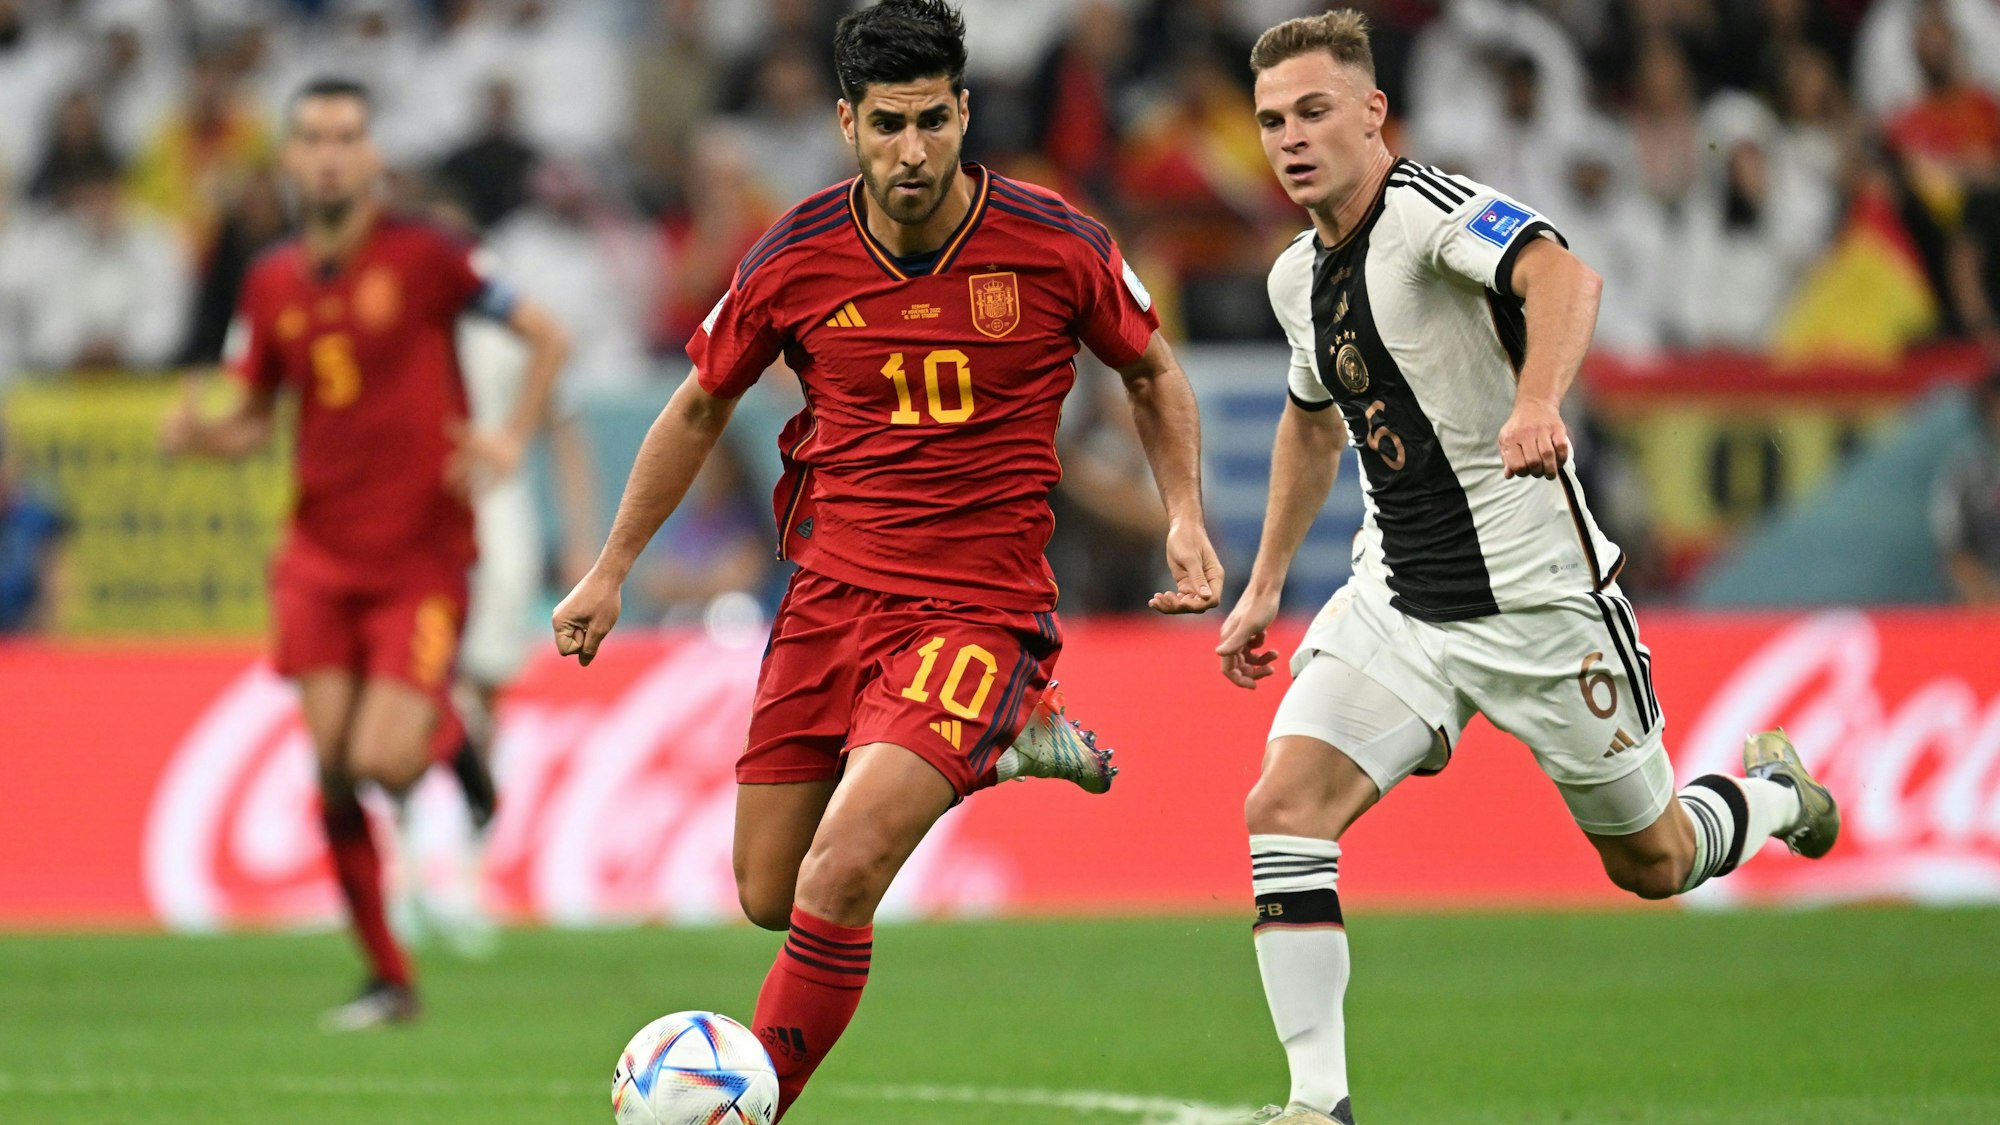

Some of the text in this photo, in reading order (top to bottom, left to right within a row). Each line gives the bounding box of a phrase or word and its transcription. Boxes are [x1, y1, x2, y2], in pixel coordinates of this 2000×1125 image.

[880, 349, 974, 424] 10
[1365, 400, 1405, 471] 6
[901, 636, 998, 720] 10
[1578, 651, 1618, 720] 6
